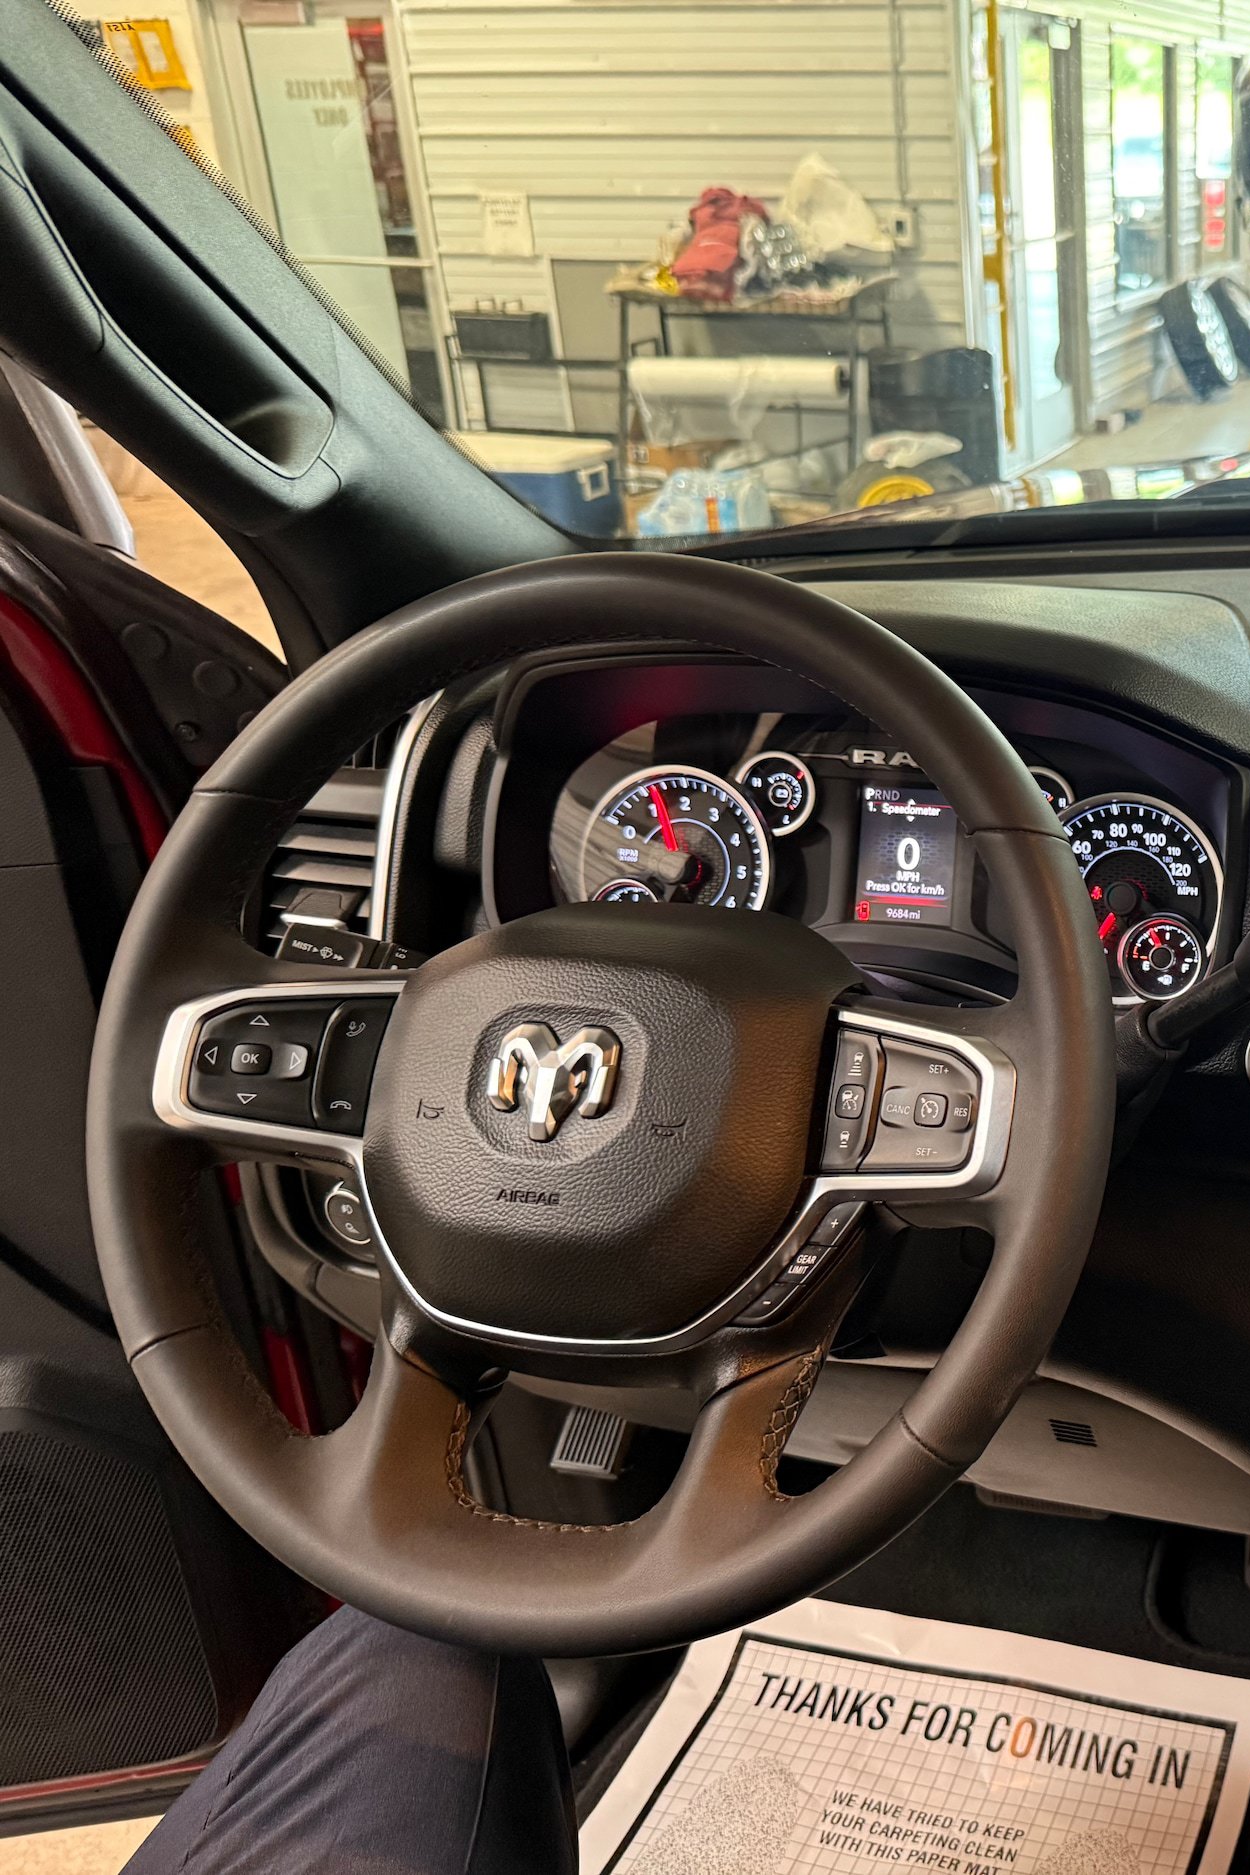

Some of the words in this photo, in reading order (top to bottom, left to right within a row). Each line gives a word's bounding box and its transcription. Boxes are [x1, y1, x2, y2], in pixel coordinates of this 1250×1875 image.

[853, 749, 921, 768] RA
[864, 787, 900, 801] PRND
[678, 796, 691, 811] 2
[882, 803, 941, 816] Speedometer
[708, 807, 720, 822] 3
[622, 825, 636, 840] 0
[1091, 830, 1104, 840] 70
[1109, 823, 1128, 838] 80
[1131, 824, 1144, 834] 90
[730, 833, 741, 847] 4
[1105, 840, 1118, 848] 120
[1143, 833, 1166, 847] 100
[897, 837, 921, 871] 0
[1072, 840, 1092, 855] 60
[1167, 846, 1181, 856] 110
[736, 865, 747, 880] 5
[896, 870, 920, 883] MPH
[1169, 863, 1192, 877] 120
[866, 880, 890, 893] Press
[891, 882, 907, 893] OK
[907, 883, 921, 894] for
[921, 884, 945, 896] km/h
[1177, 886, 1198, 897] MPH
[886, 907, 909, 919] 9684
[291, 939, 313, 952] MIST
[241, 1052, 260, 1064] OK
[886, 1104, 911, 1115] CANC
[953, 1107, 968, 1117] RES
[796, 1254, 817, 1264] GEAR
[787, 1265, 809, 1275] LIMIT
[754, 1671, 896, 1731] THANKS
[900, 1699, 978, 1748] FOR
[986, 1712, 1139, 1780] COMING
[1147, 1745, 1191, 1790] IN
[831, 1789, 859, 1807] WE
[860, 1797, 903, 1819] HAVE
[907, 1808, 953, 1830] TRIED
[957, 1818, 979, 1834] TO
[982, 1823, 1026, 1842] KEEP
[820, 1808, 866, 1832] YOUR
[869, 1820, 961, 1851] CARPETING
[964, 1840, 1018, 1863] CLEAN
[819, 1830, 861, 1852] WITH
[866, 1840, 904, 1861] THIS
[906, 1849, 962, 1870] PAPER
[963, 1861, 1001, 1875] MAT
